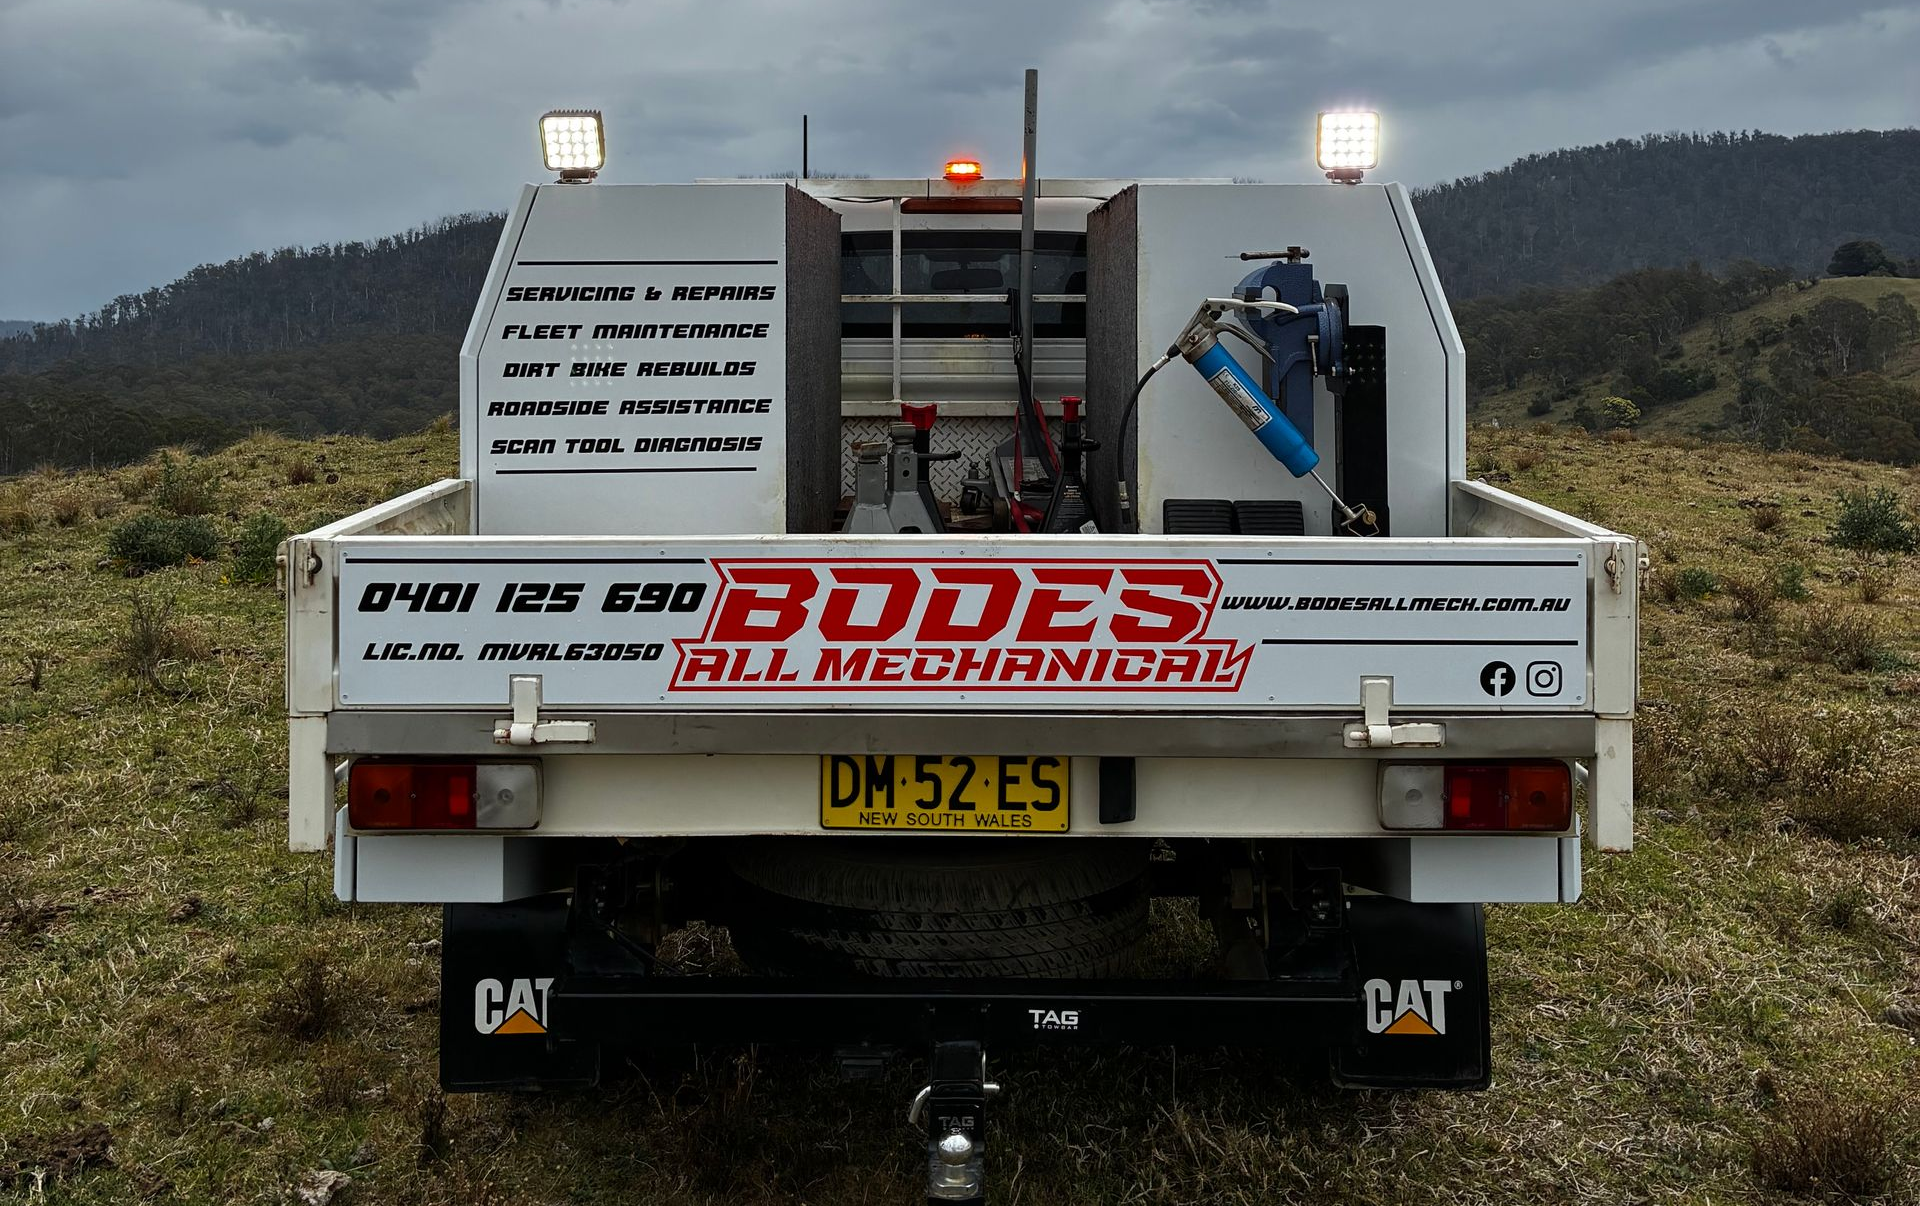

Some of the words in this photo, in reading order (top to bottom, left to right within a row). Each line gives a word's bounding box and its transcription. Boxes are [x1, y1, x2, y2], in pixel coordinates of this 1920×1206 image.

[506, 286, 635, 302] SERVICING
[644, 287, 663, 301] &
[672, 286, 777, 301] REPAIRS
[501, 324, 583, 340] FLEET
[592, 323, 770, 340] MAINTENANCE
[502, 362, 561, 378] DIRT
[569, 362, 627, 378] BIKE
[636, 361, 757, 378] REBUILDS
[487, 400, 610, 417] ROADSIDE
[618, 398, 773, 416] ASSISTANCE
[490, 438, 557, 455] SCAN
[565, 438, 625, 454] TOOL
[633, 437, 763, 454] DIAGNOSIS
[357, 582, 481, 613] 0401
[495, 582, 586, 613] 125
[600, 582, 708, 613] 690
[711, 567, 1214, 642] BODES
[1220, 595, 1572, 612] WWW.BODESALLMECH.COM.AU
[362, 642, 464, 661] LIC.NO.
[477, 643, 665, 661] MVRL63050
[681, 647, 800, 683] ALL
[812, 647, 1238, 684] MECHANICAL
[858, 812, 899, 826] NEW
[906, 812, 965, 827] SOUTH
[974, 813, 1033, 828] WALES
[475, 978, 555, 1035] CAT
[1028, 1009, 1079, 1025] TAG
[938, 1116, 975, 1127] TAG
